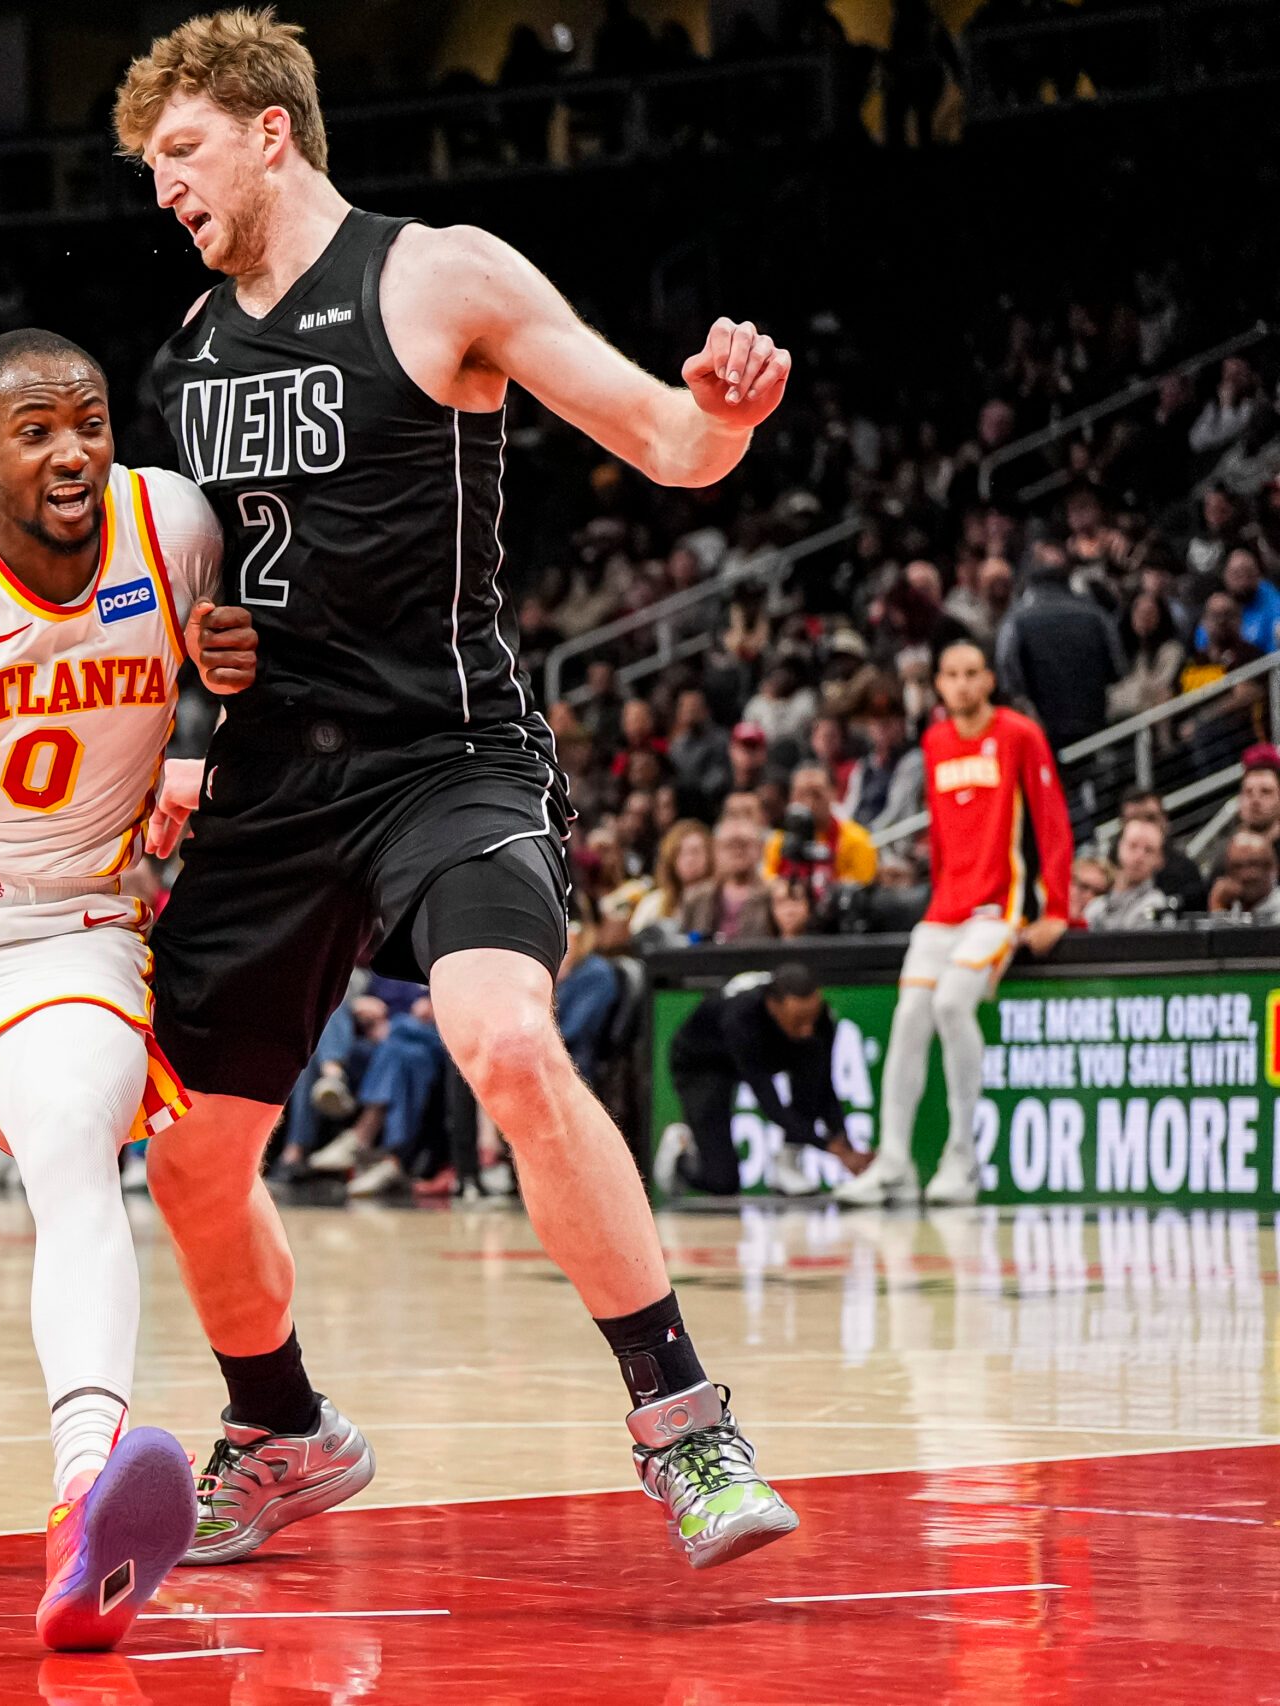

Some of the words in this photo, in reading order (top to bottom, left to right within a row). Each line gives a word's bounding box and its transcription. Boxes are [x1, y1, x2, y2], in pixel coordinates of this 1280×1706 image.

[299, 313, 315, 331] All
[316, 312, 327, 327] In
[327, 307, 352, 324] Won
[181, 364, 345, 486] NETS
[237, 491, 292, 608] 2
[100, 587, 150, 616] paze
[0, 726, 85, 814] 0
[999, 999, 1042, 1043] THE
[1045, 998, 1113, 1042] MORE
[1116, 996, 1164, 1041] YOU
[1166, 993, 1258, 1040] ORDER,
[981, 1044, 1006, 1088] HE
[1008, 1043, 1076, 1088] MORE
[1078, 1043, 1125, 1088] YOU
[1128, 1041, 1188, 1088] SAVE
[1191, 1040, 1258, 1087] WITH
[1009, 1096, 1085, 1192] OR
[1095, 1095, 1260, 1193] MORE
